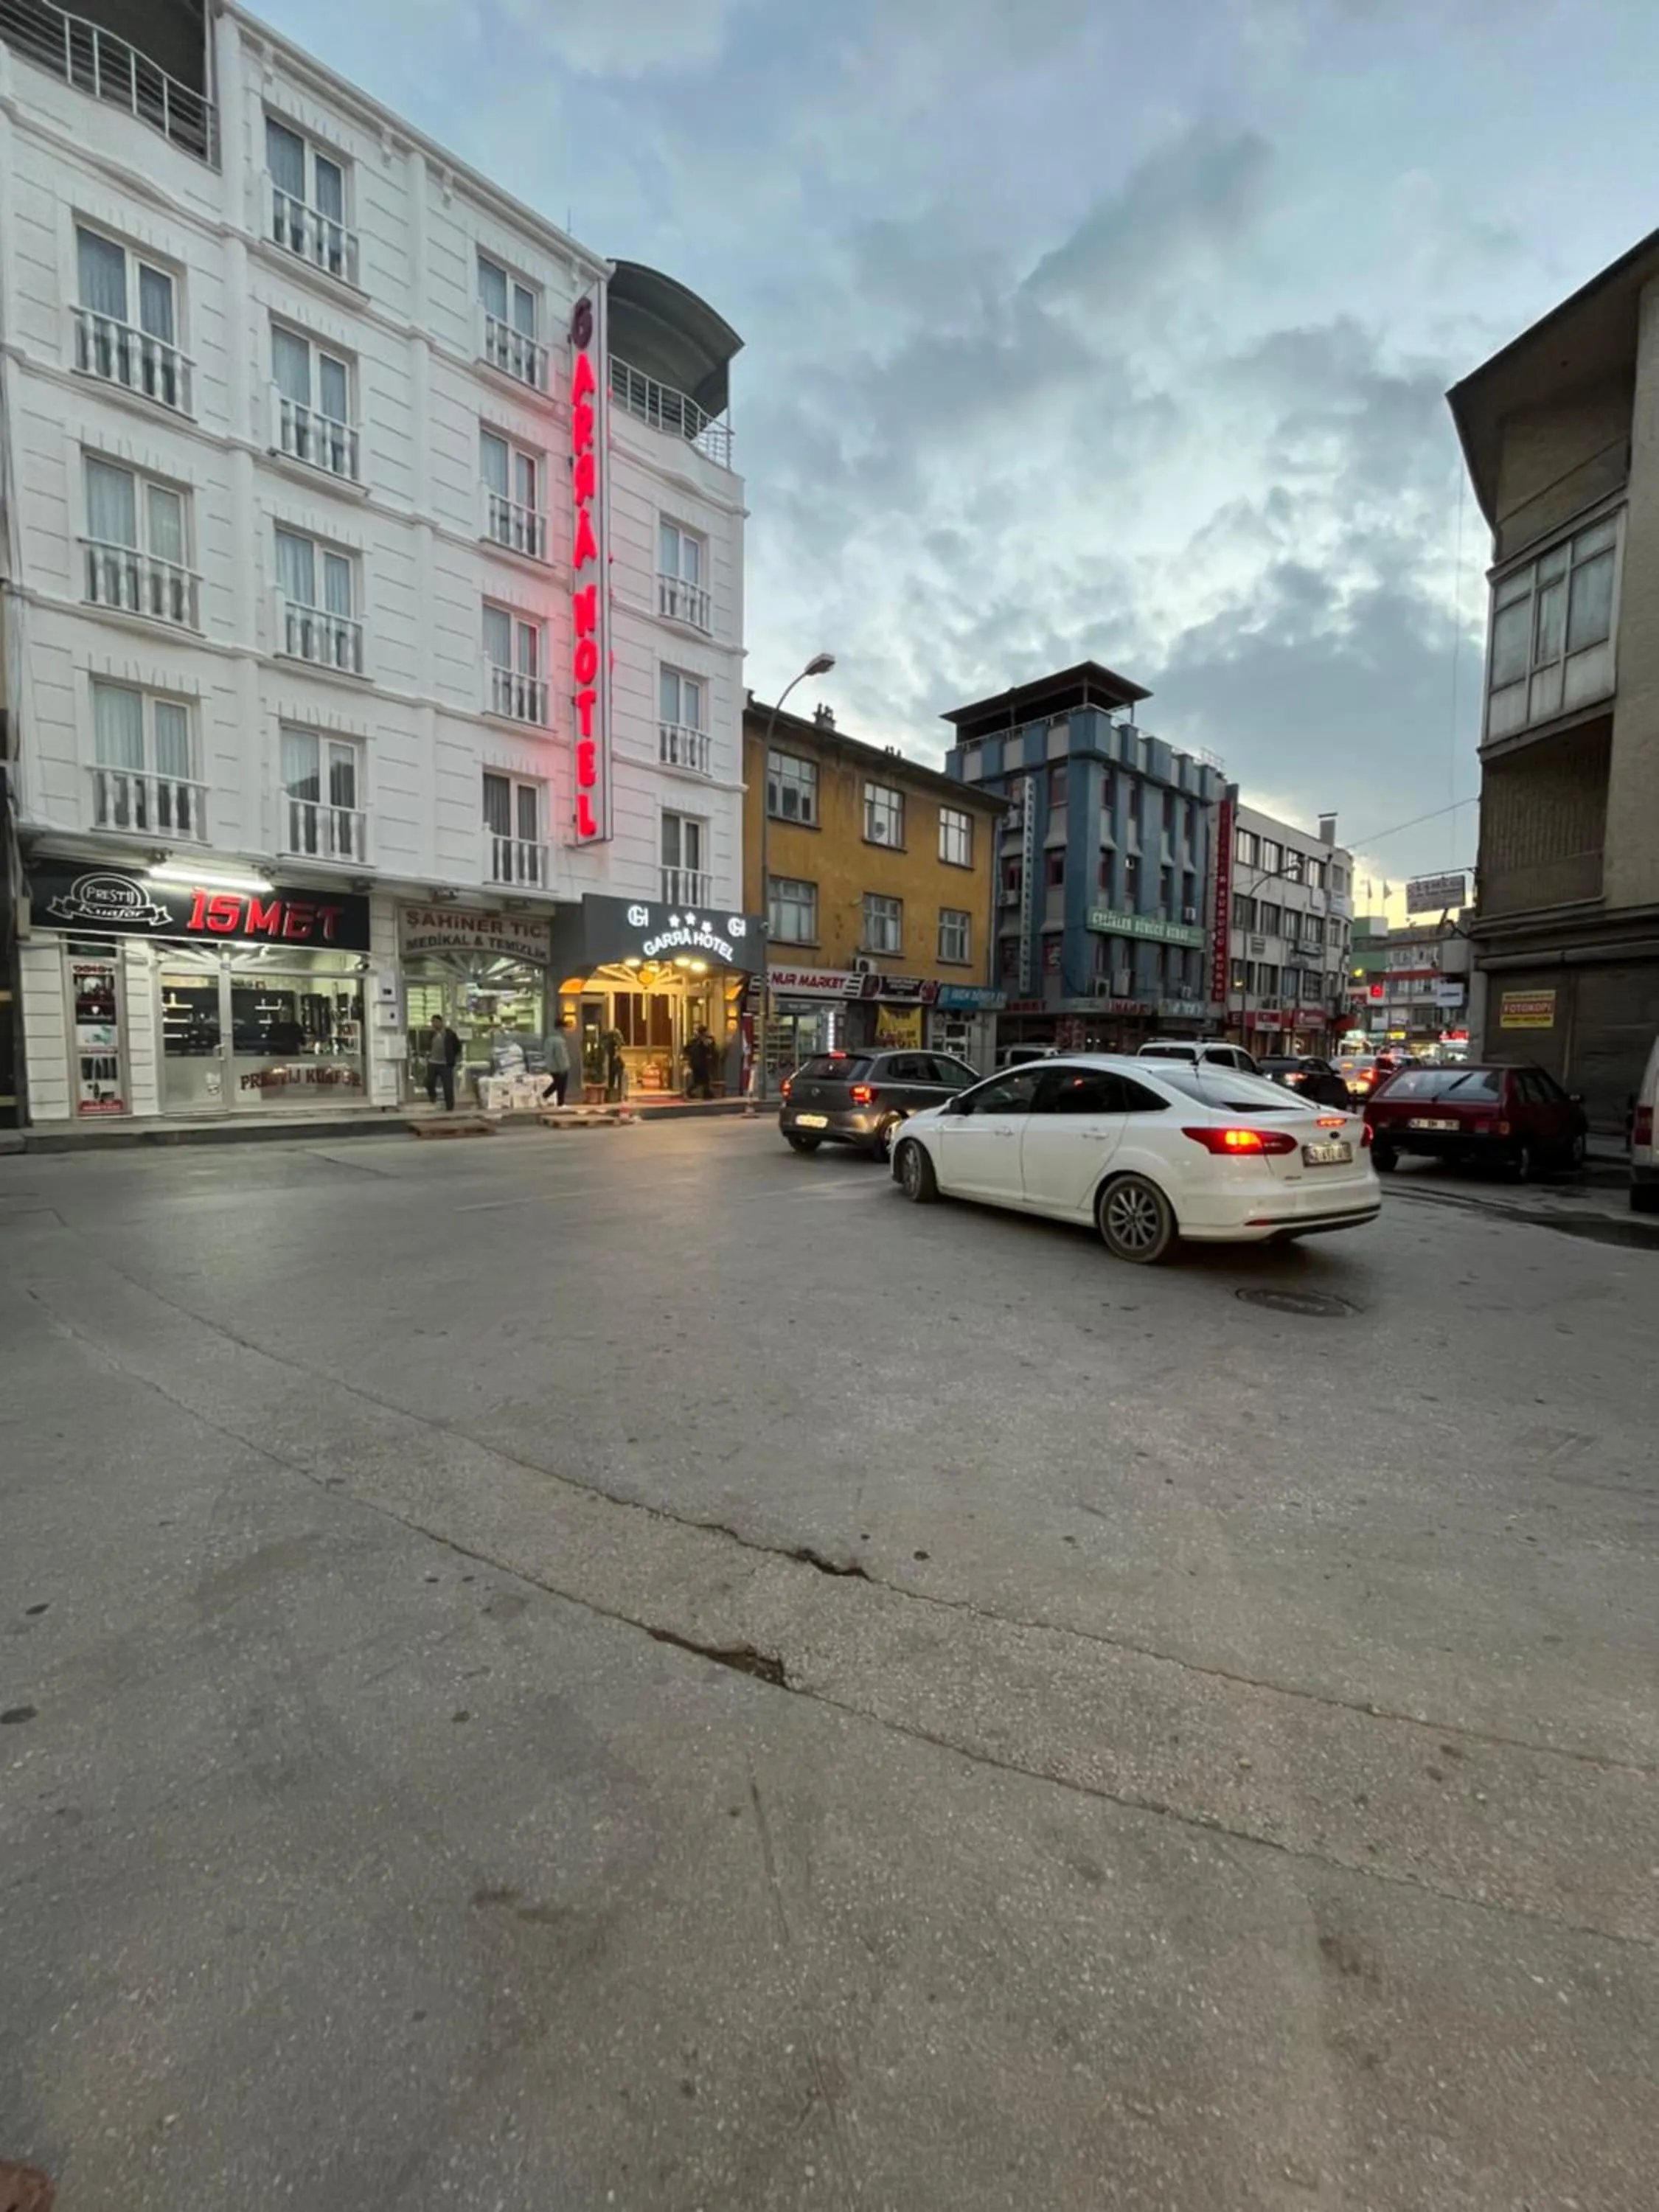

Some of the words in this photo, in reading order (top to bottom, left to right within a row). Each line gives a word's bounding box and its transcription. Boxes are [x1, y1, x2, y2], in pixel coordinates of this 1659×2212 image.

[572, 583, 598, 837] HOTEL
[693, 931, 734, 962] HOTEL
[771, 971, 797, 986] NUR
[799, 975, 846, 990] MARKET
